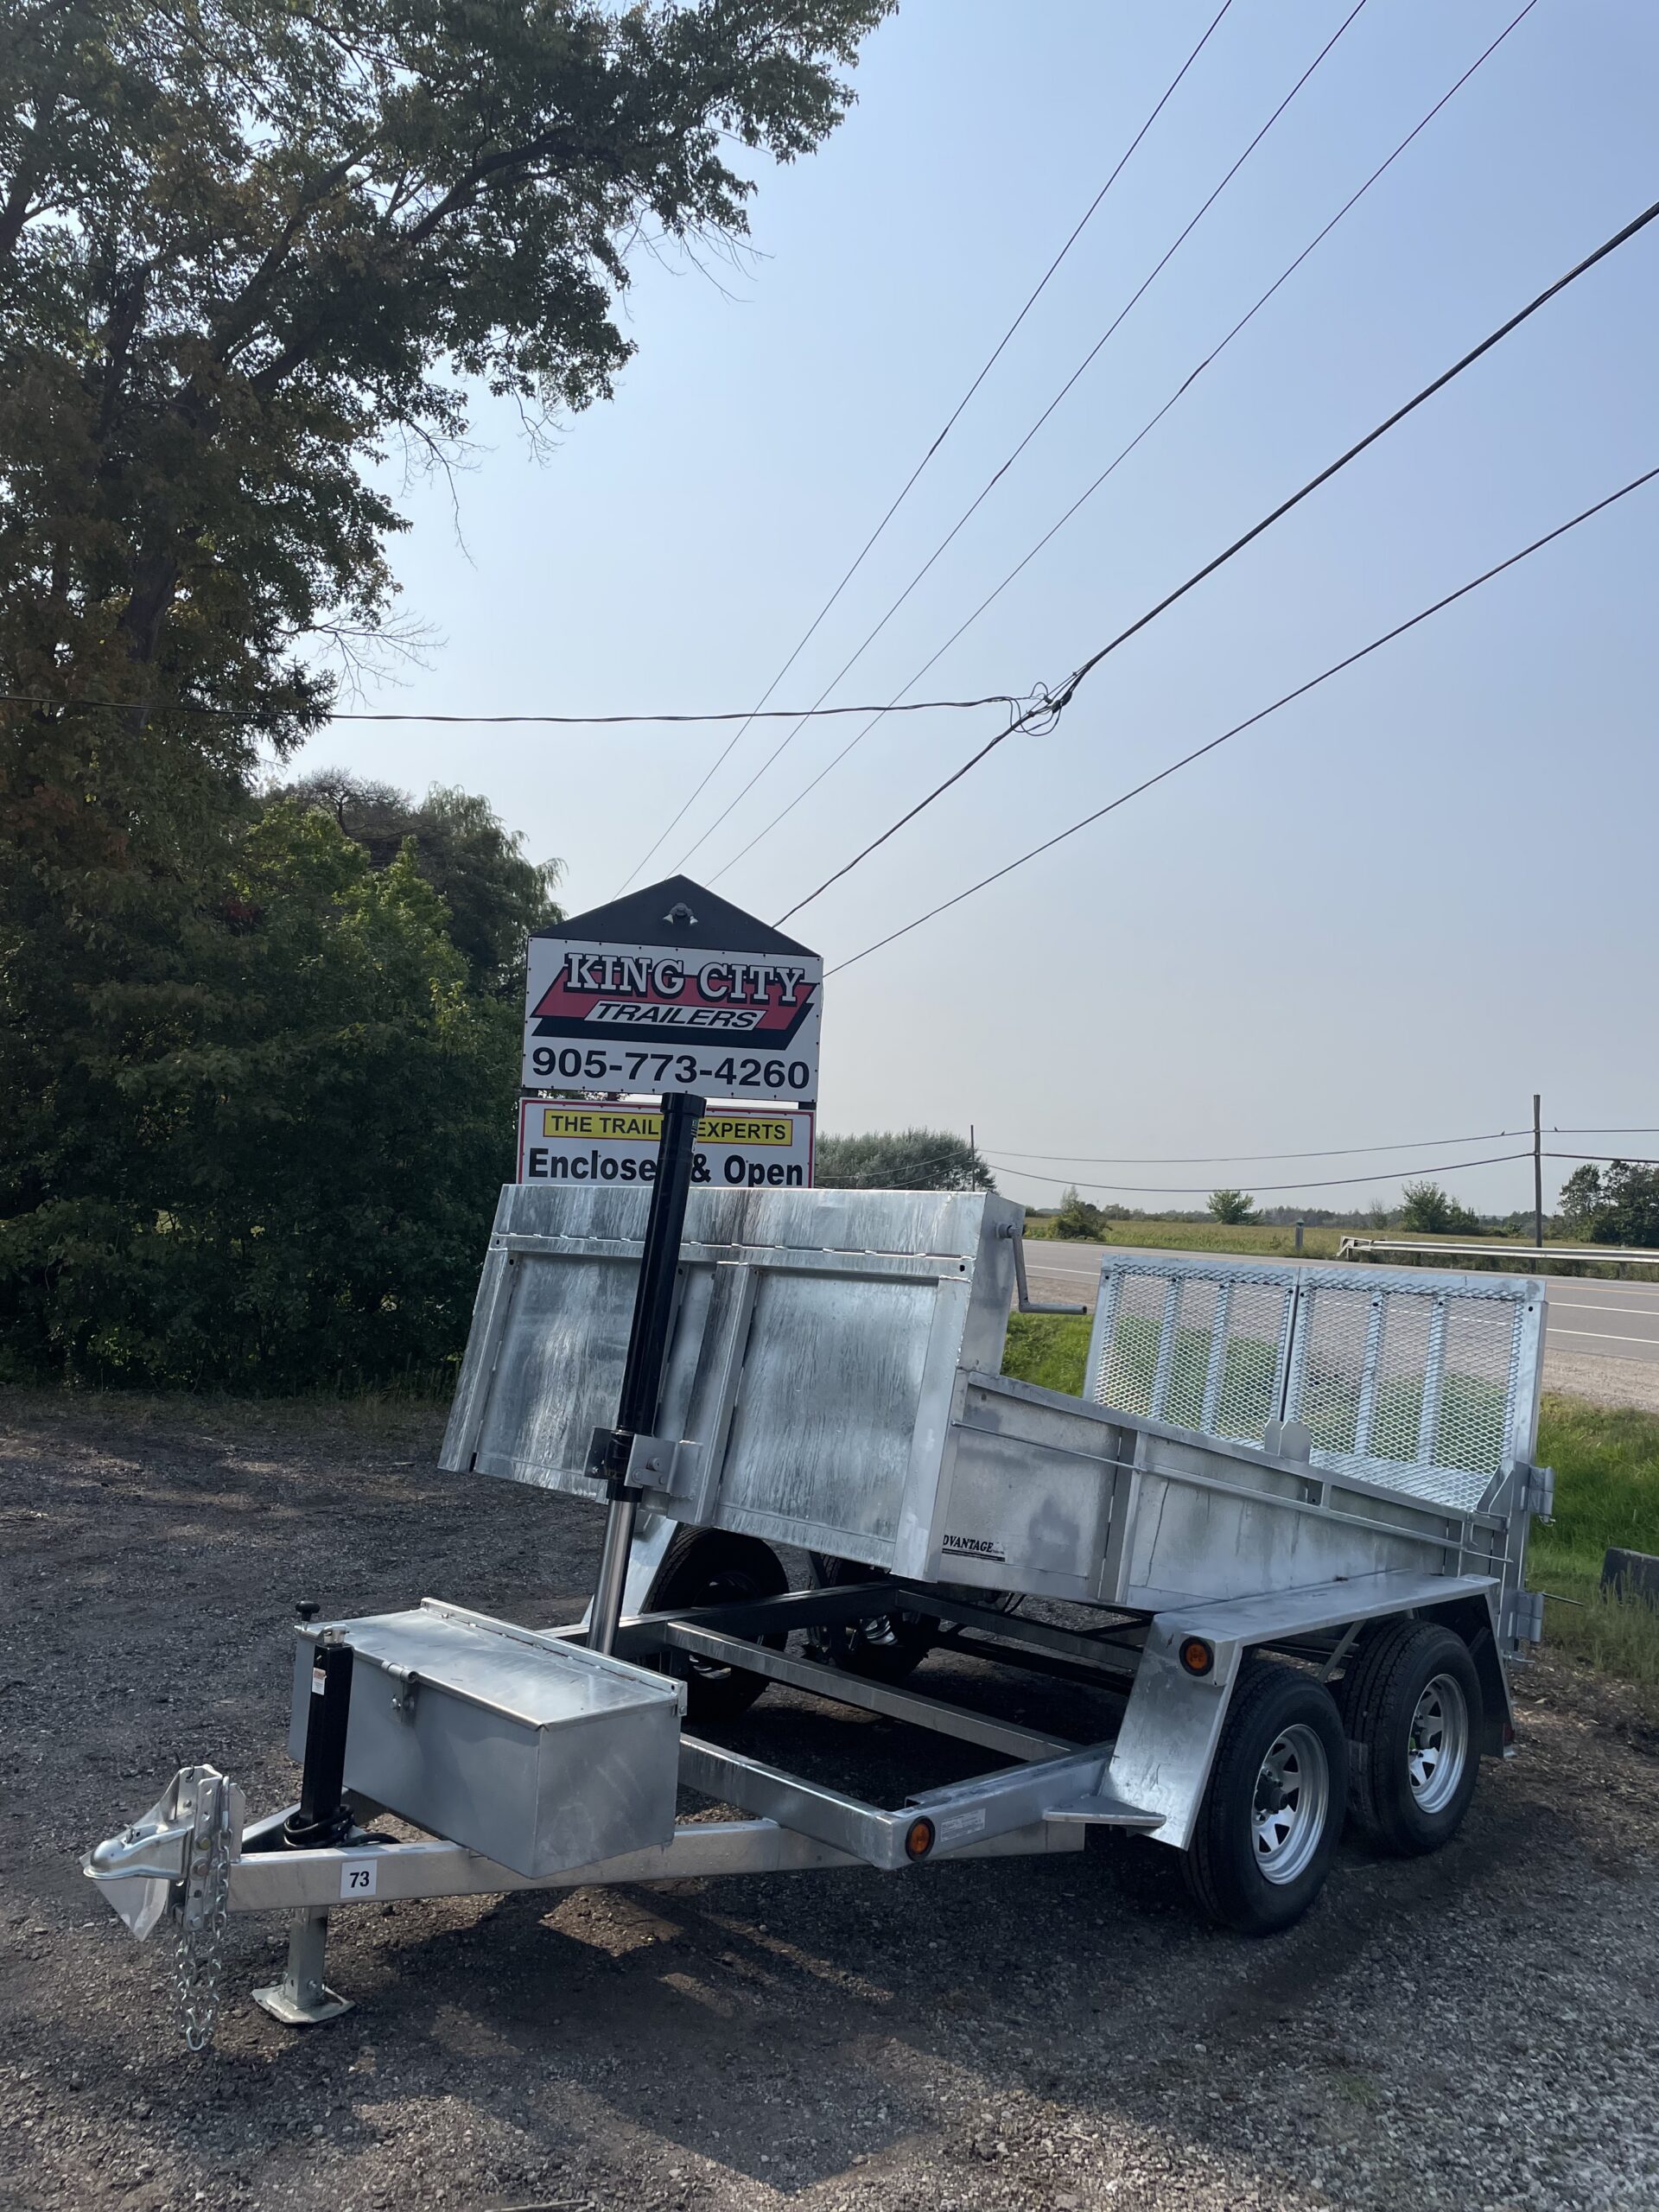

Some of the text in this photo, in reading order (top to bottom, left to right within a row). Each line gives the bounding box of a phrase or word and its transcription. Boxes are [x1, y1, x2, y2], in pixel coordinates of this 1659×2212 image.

[564, 952, 804, 1005] KING CITY
[597, 1003, 758, 1028] TRAILERS
[531, 1046, 810, 1089] 905-773-4260
[551, 1115, 592, 1133] THE
[599, 1117, 664, 1136] TRAIL
[697, 1122, 785, 1141] EXPERTS
[528, 1147, 803, 1187] Enclose & Open
[943, 1535, 994, 1553] DVANTAGE
[349, 1871, 370, 1888] 73
